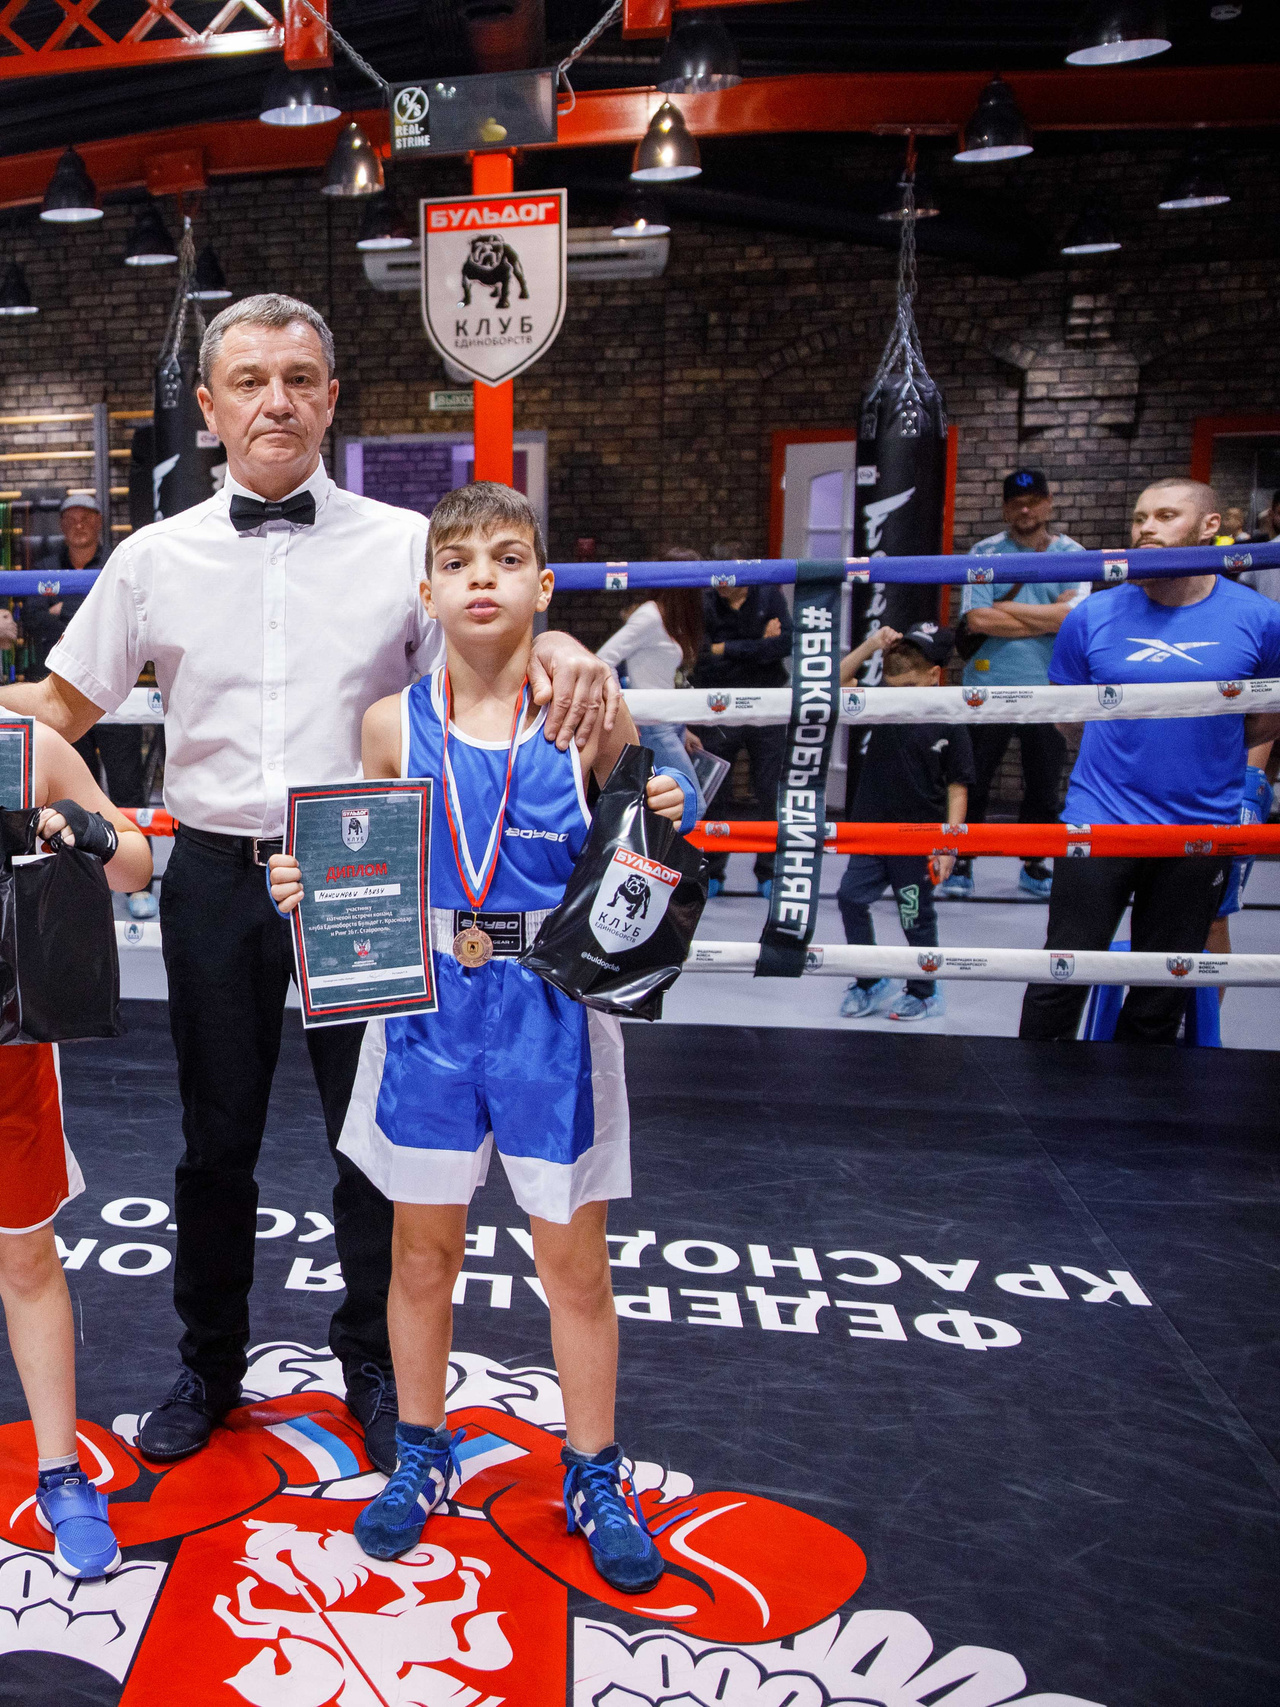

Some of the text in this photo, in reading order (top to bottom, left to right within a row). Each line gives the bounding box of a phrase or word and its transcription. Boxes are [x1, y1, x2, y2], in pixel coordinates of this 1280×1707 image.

[395, 135, 430, 149] STRIKE
[430, 202, 555, 228] БУЛЬДОГ
[455, 316, 533, 337] КЛУБ
[454, 336, 532, 349] ЕДИНОБОРСТВ
[437, 395, 473, 404] ВЫХО
[776, 606, 832, 940] #БОКСОБЪЕДИНЯЕТ
[505, 827, 569, 842] BOYBO
[326, 863, 388, 883] ДИПЛОМ
[615, 851, 680, 885] БУЛЬДОГ
[326, 914, 351, 922] матчевой
[598, 911, 642, 938] КЛУБ
[594, 921, 636, 944] ЕДИНОБОРСТВ
[580, 951, 620, 972] @buldogclub
